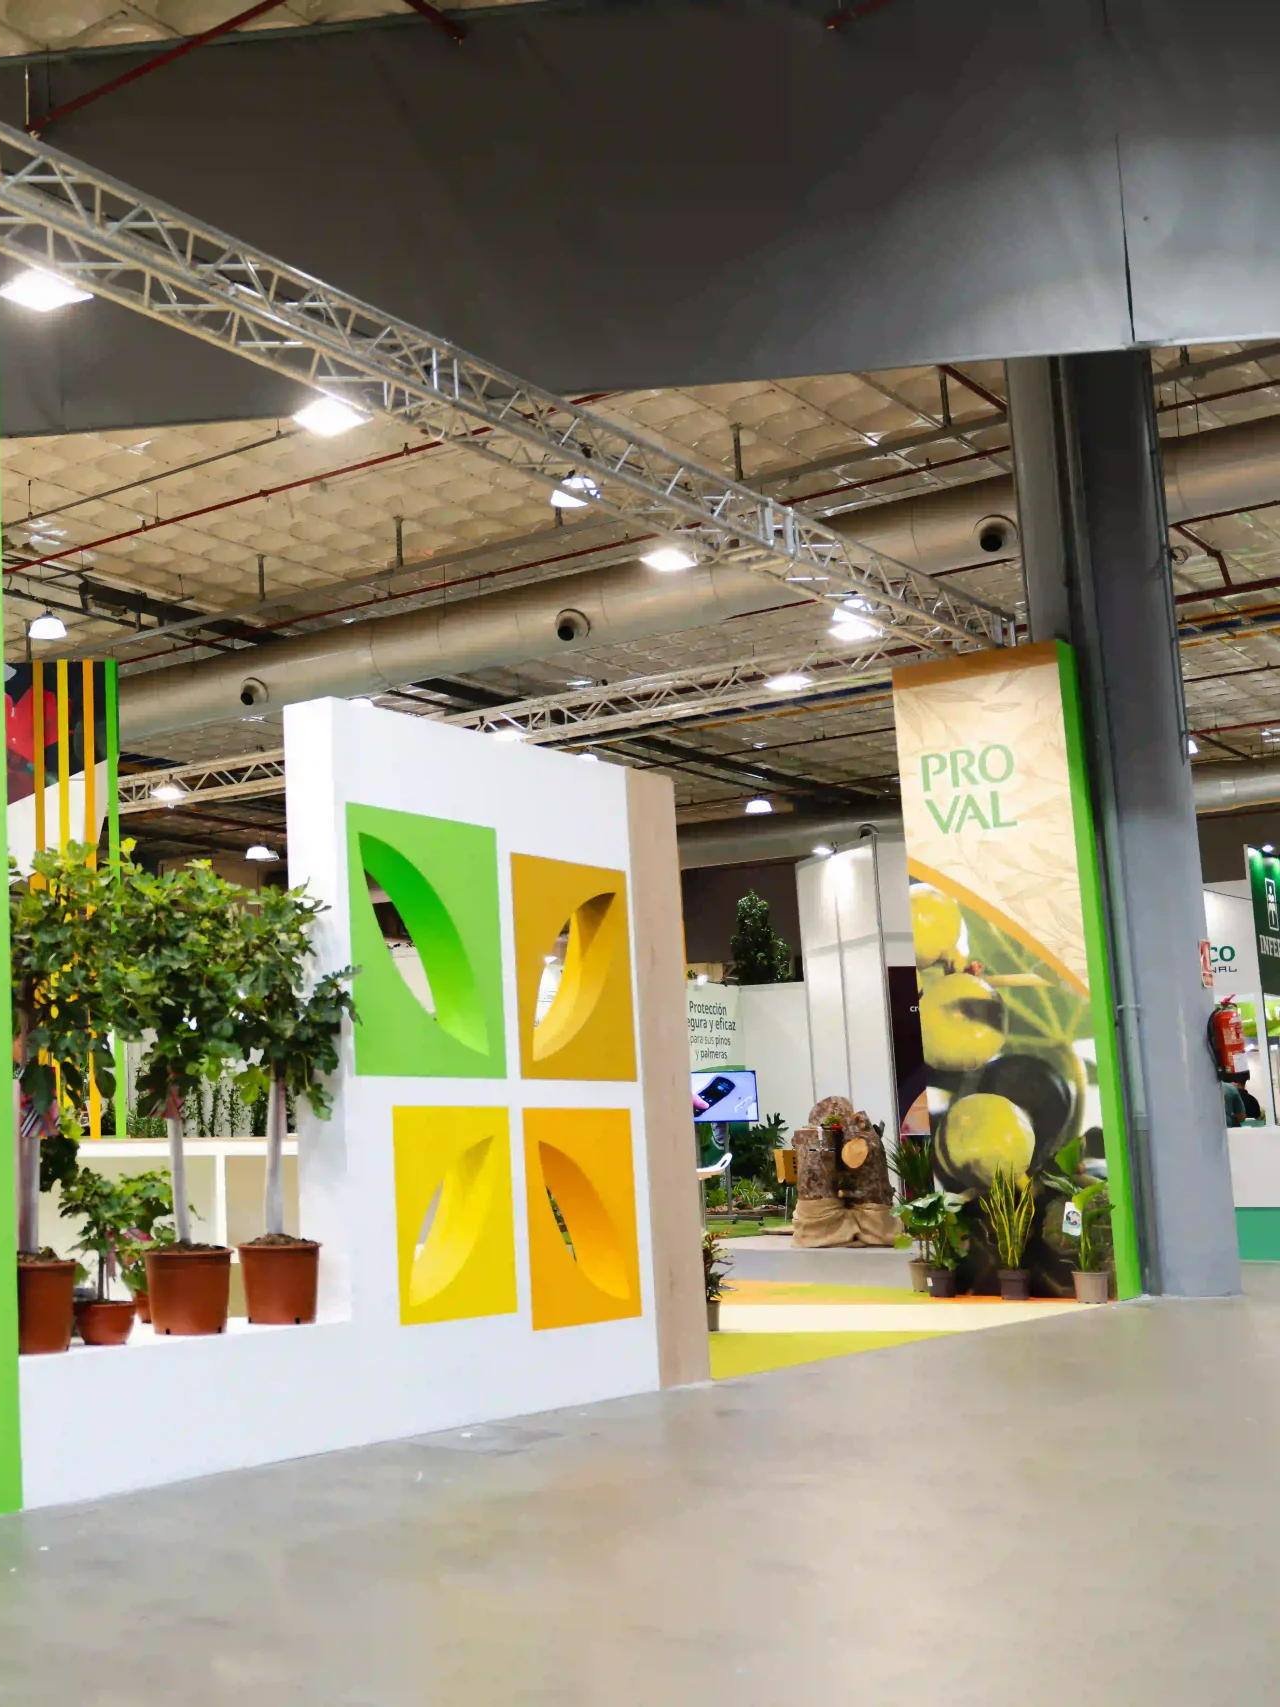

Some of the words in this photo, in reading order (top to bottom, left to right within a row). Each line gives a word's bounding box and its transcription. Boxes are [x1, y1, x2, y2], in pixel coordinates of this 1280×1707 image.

[921, 744, 1014, 792] PRO
[924, 790, 1017, 834] VAL
[689, 1000, 727, 1016] Protección
[708, 1019, 714, 1033] y
[715, 1017, 736, 1031] eficaz
[690, 1035, 703, 1046] para
[704, 1036, 714, 1045] sus
[715, 1034, 731, 1048] pinos
[695, 1049, 700, 1061] y
[700, 1047, 728, 1061] palmeras
